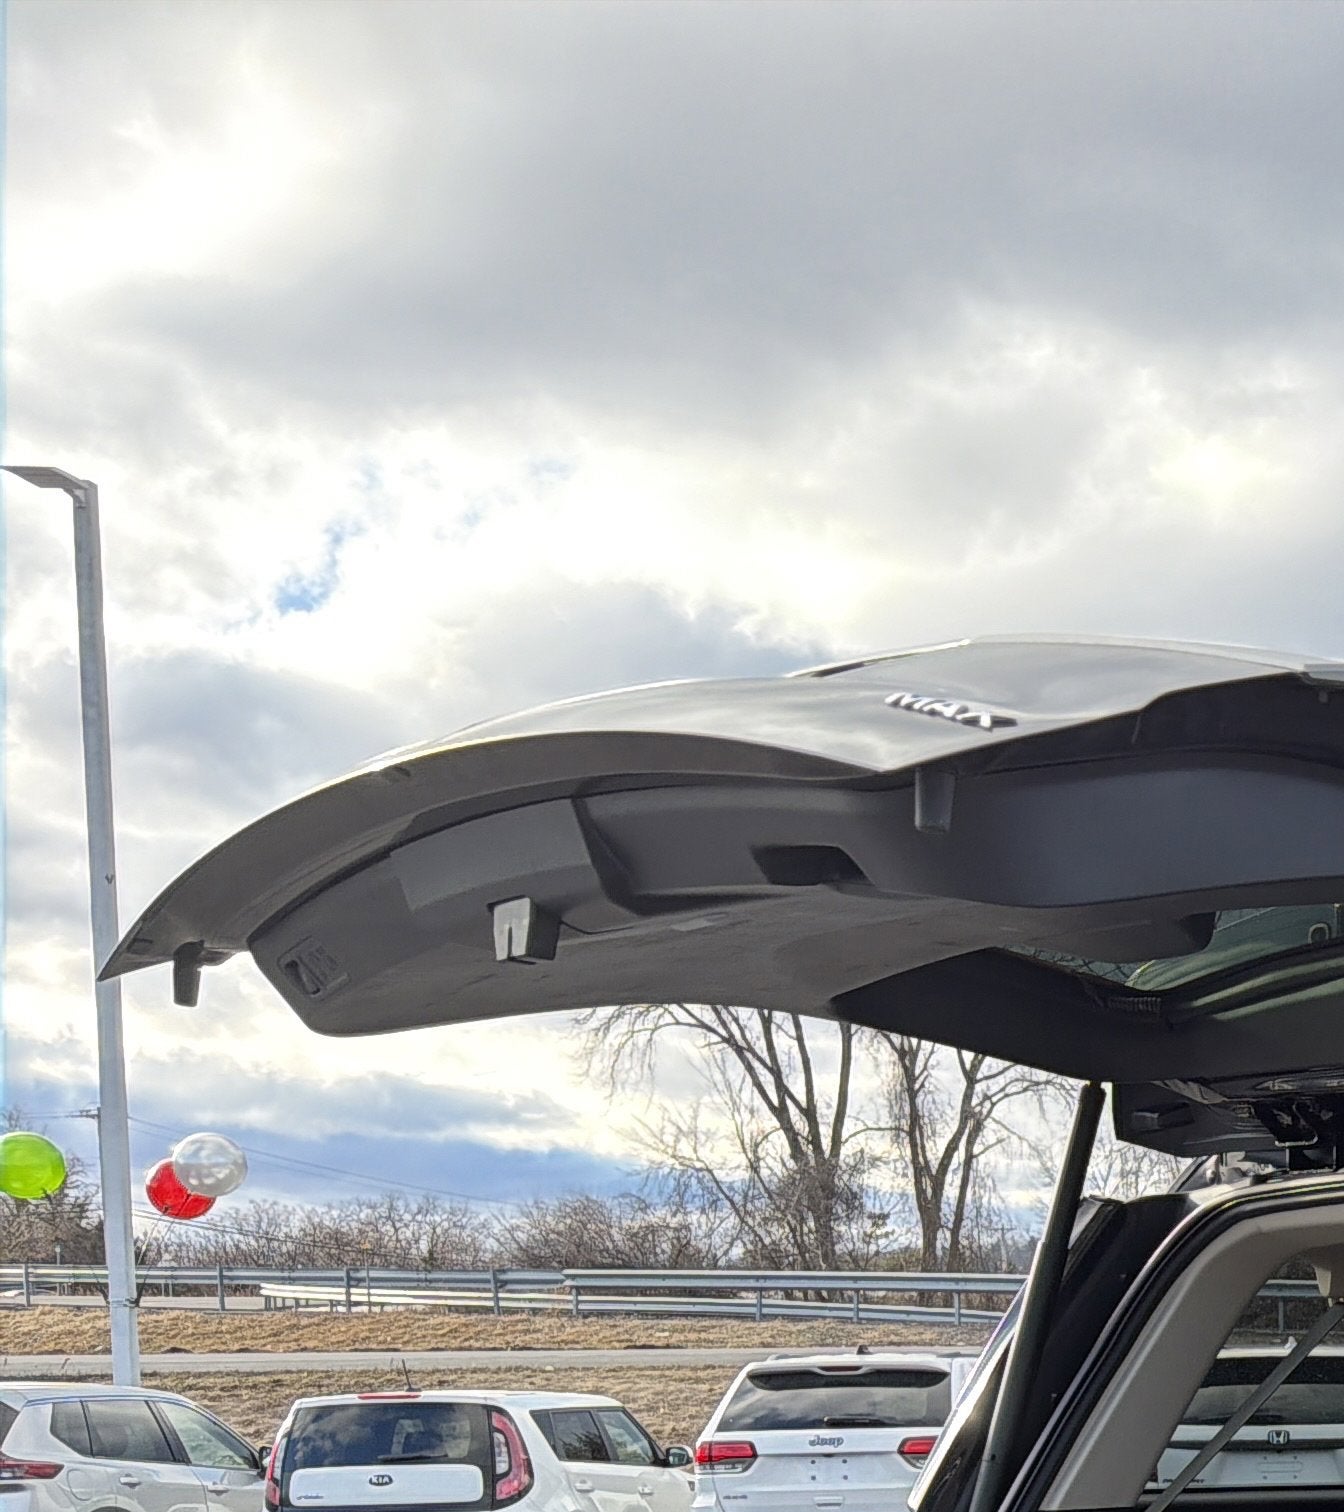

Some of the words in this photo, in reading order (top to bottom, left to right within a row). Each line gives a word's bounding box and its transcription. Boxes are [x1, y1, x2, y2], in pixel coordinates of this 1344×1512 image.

[883, 691, 1018, 732] MAX
[808, 1434, 845, 1449] Jeep
[370, 1475, 391, 1485] KIA
